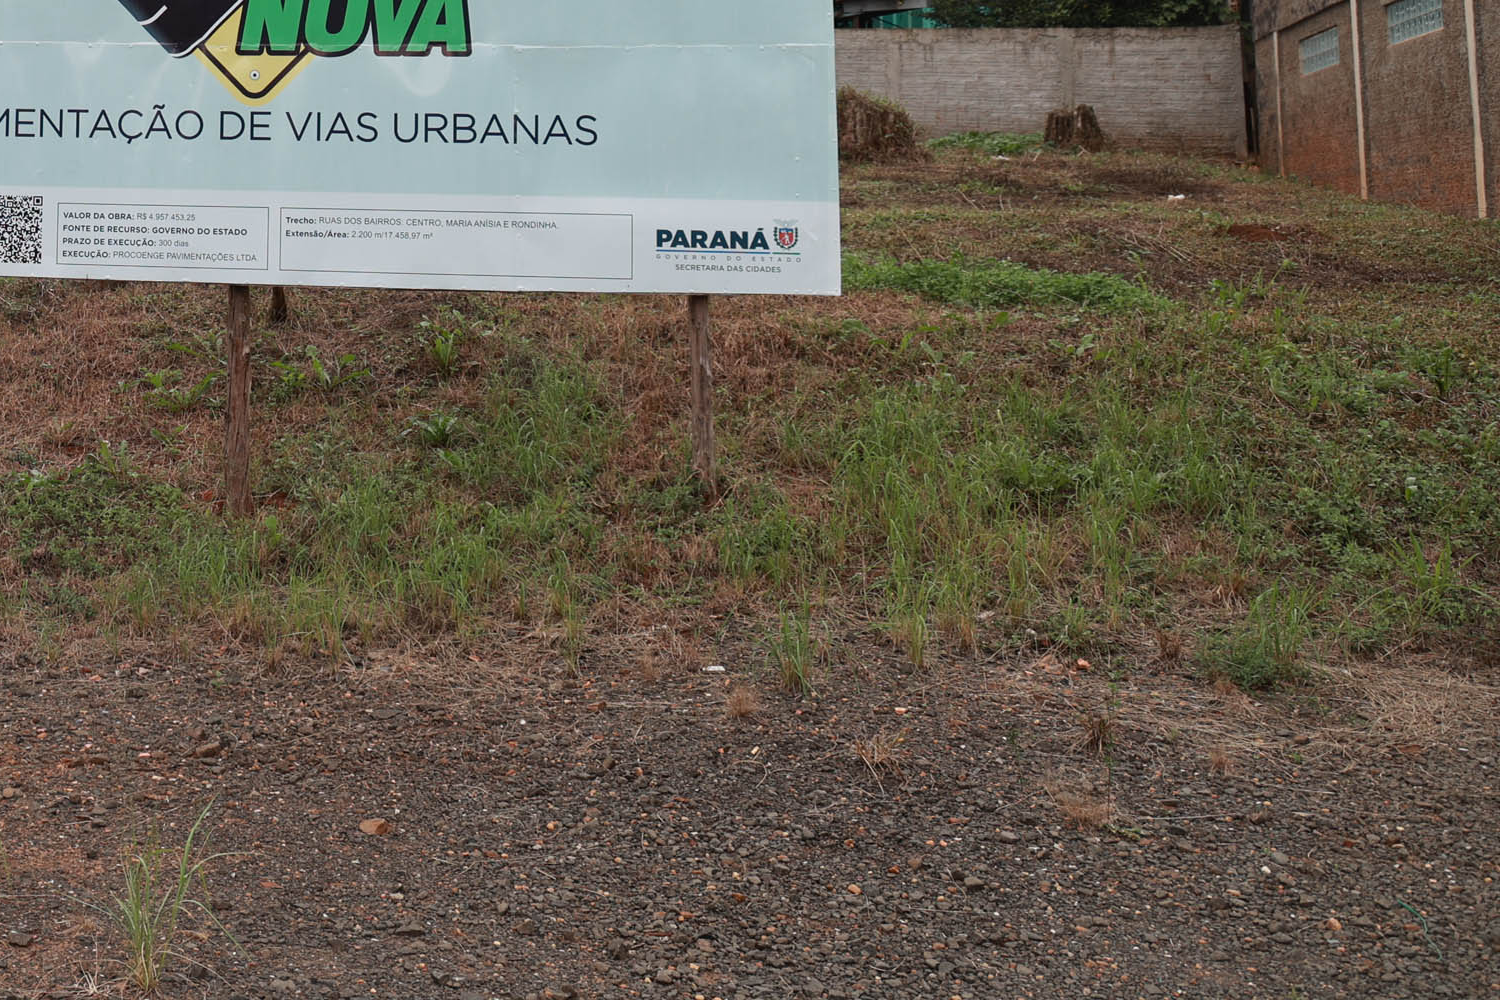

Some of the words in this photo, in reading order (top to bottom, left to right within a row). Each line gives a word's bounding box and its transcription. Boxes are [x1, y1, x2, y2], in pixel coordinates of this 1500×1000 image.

[220, 111, 271, 140] DE
[286, 112, 378, 142] VIAS
[394, 113, 598, 145] URBANAS
[137, 213, 147, 221] R$
[286, 217, 317, 225] Trecho:
[319, 217, 342, 225] RUAS
[406, 218, 443, 227] CENTRO,
[474, 219, 501, 228] ANÍSIA
[286, 230, 349, 239] Extensão/Área:
[656, 228, 770, 250] PARANÁ
[108, 238, 156, 247] EXECUÇÃO:
[63, 250, 111, 259] EXECUÇÃO:
[167, 252, 234, 262] PAVIMENTAÇÕES
[675, 264, 725, 272] SECRETARIA
